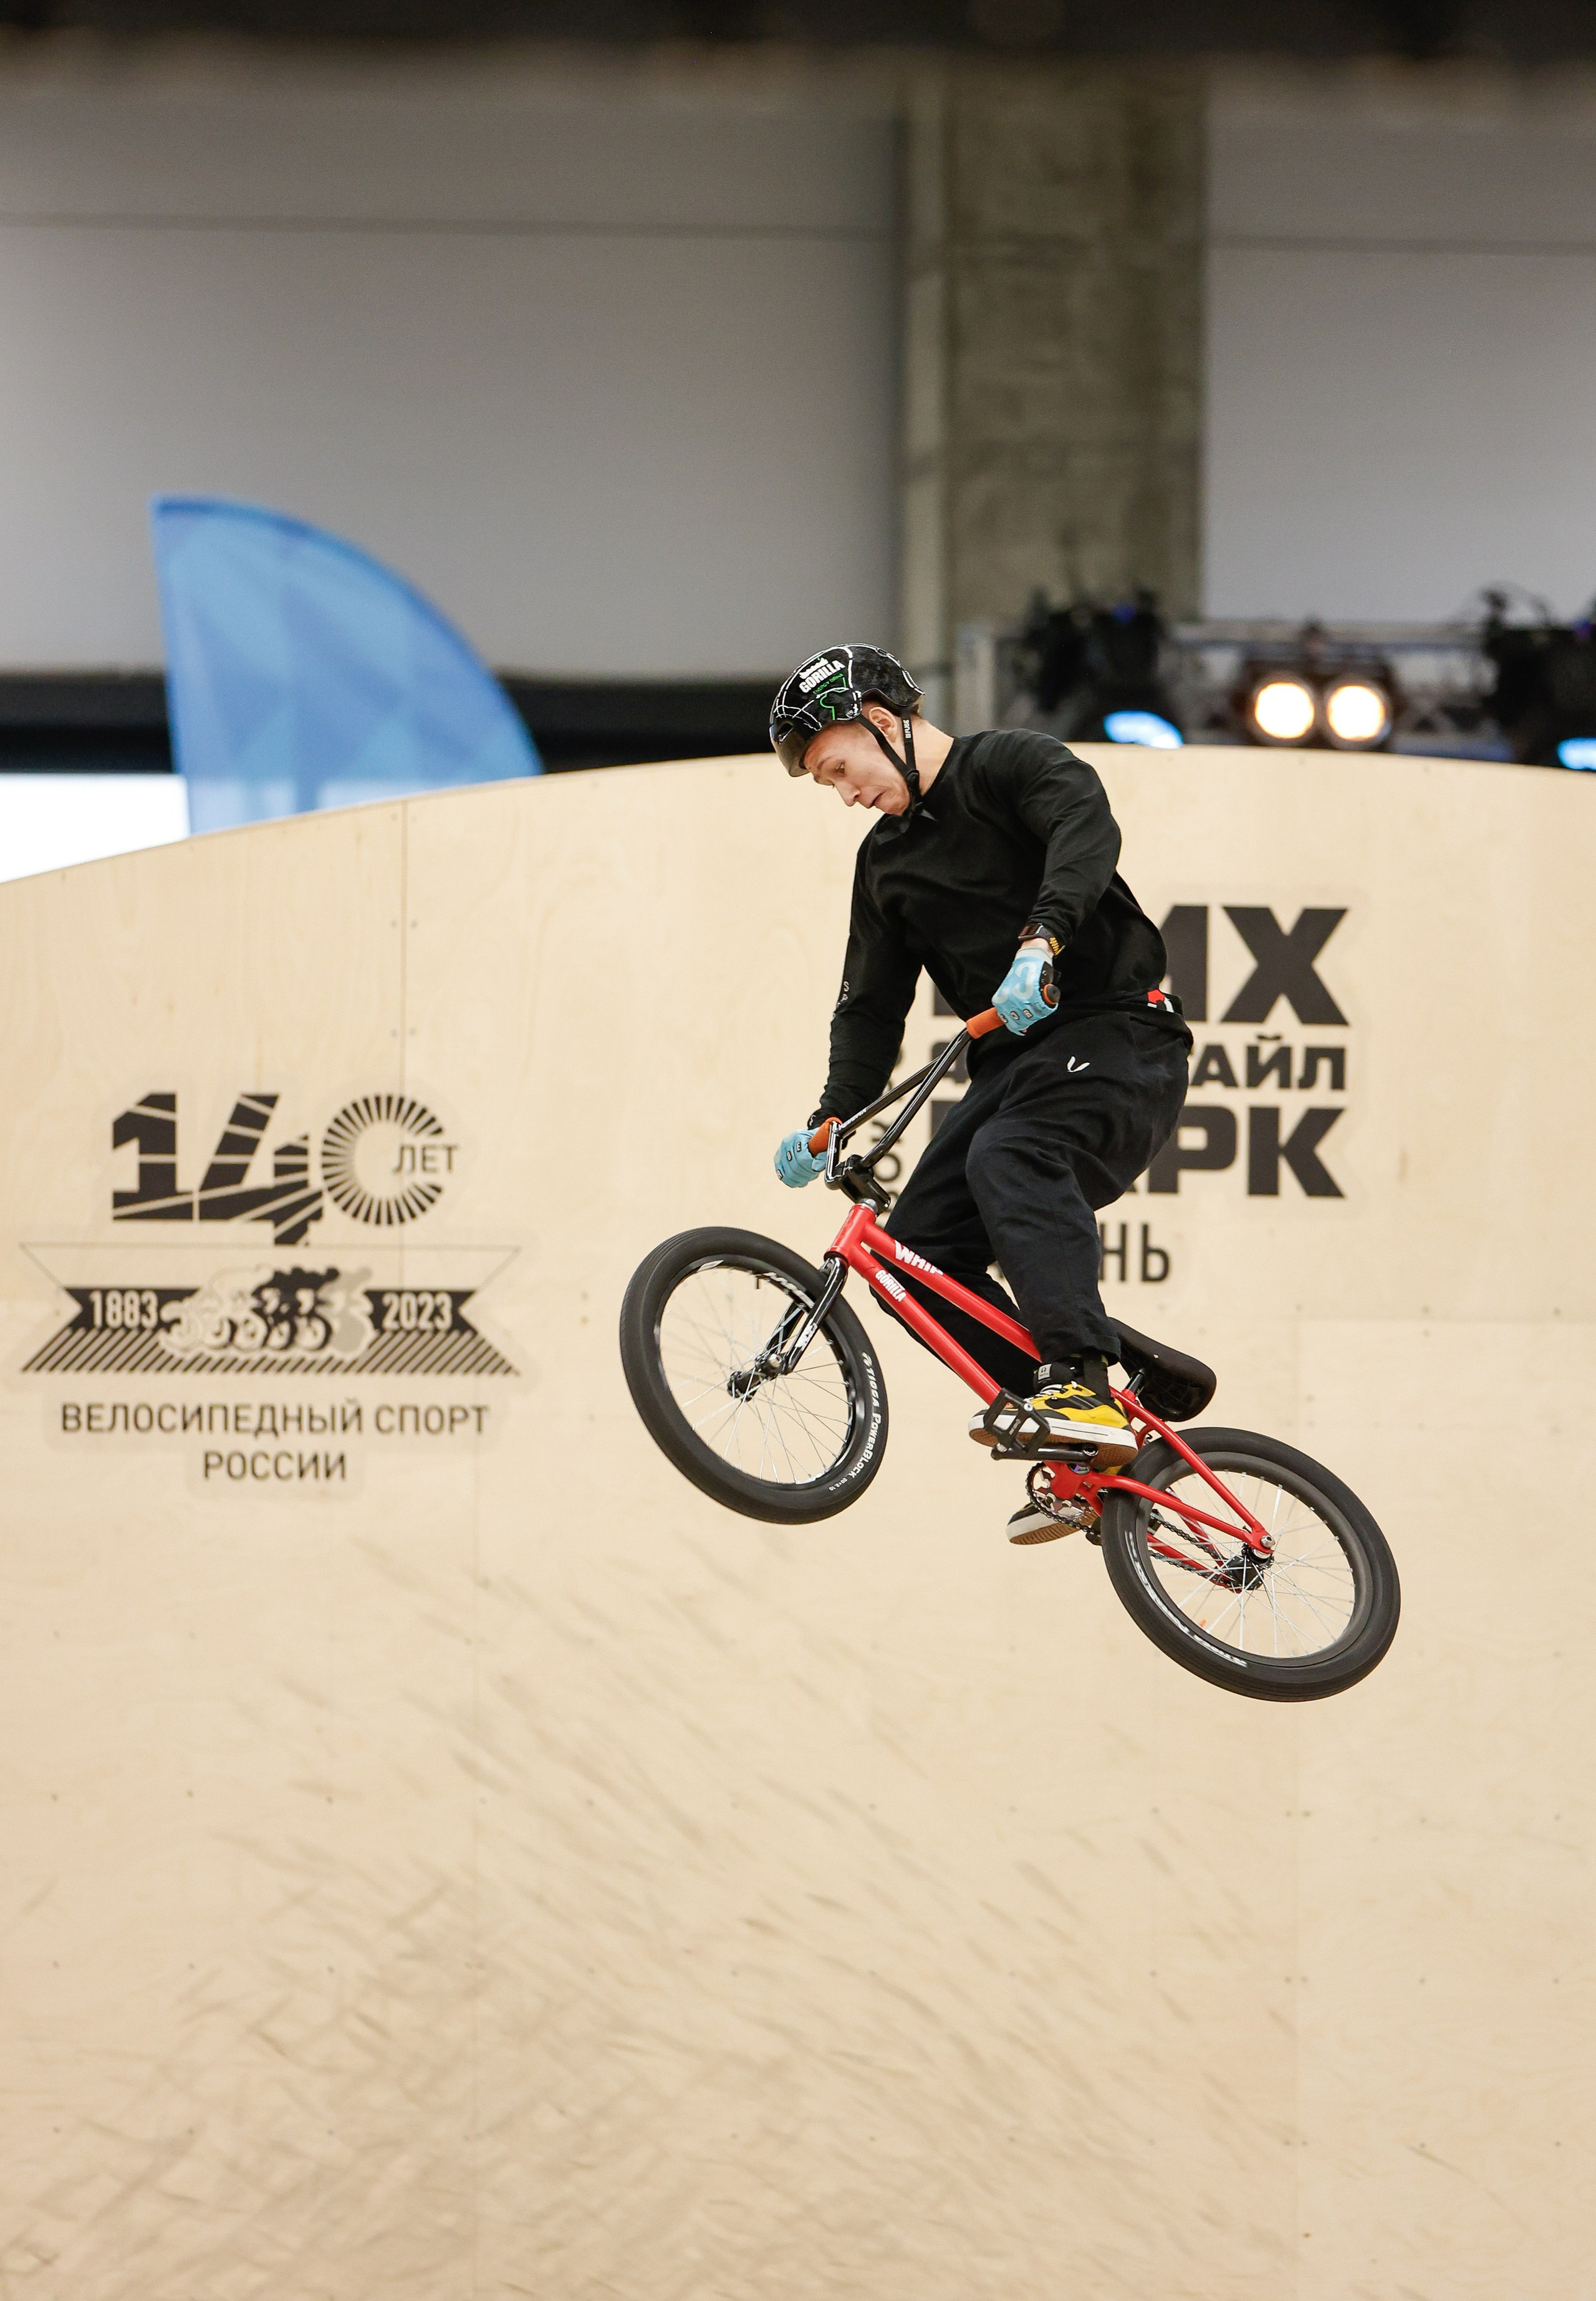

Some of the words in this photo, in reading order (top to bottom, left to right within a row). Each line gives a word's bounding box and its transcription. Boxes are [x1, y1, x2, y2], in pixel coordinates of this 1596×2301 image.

[799, 660, 846, 693] GORILLA
[394, 1145, 459, 1173] ЛЕТ
[875, 1269, 907, 1302] GORILLA
[89, 1289, 158, 1329] 1883
[382, 1291, 452, 1331] 2023
[61, 1400, 362, 1438] ВЕЛОСИПЕДНЫЙ
[375, 1405, 489, 1434] СПОРТ
[204, 1451, 347, 1480] РОССИИ
